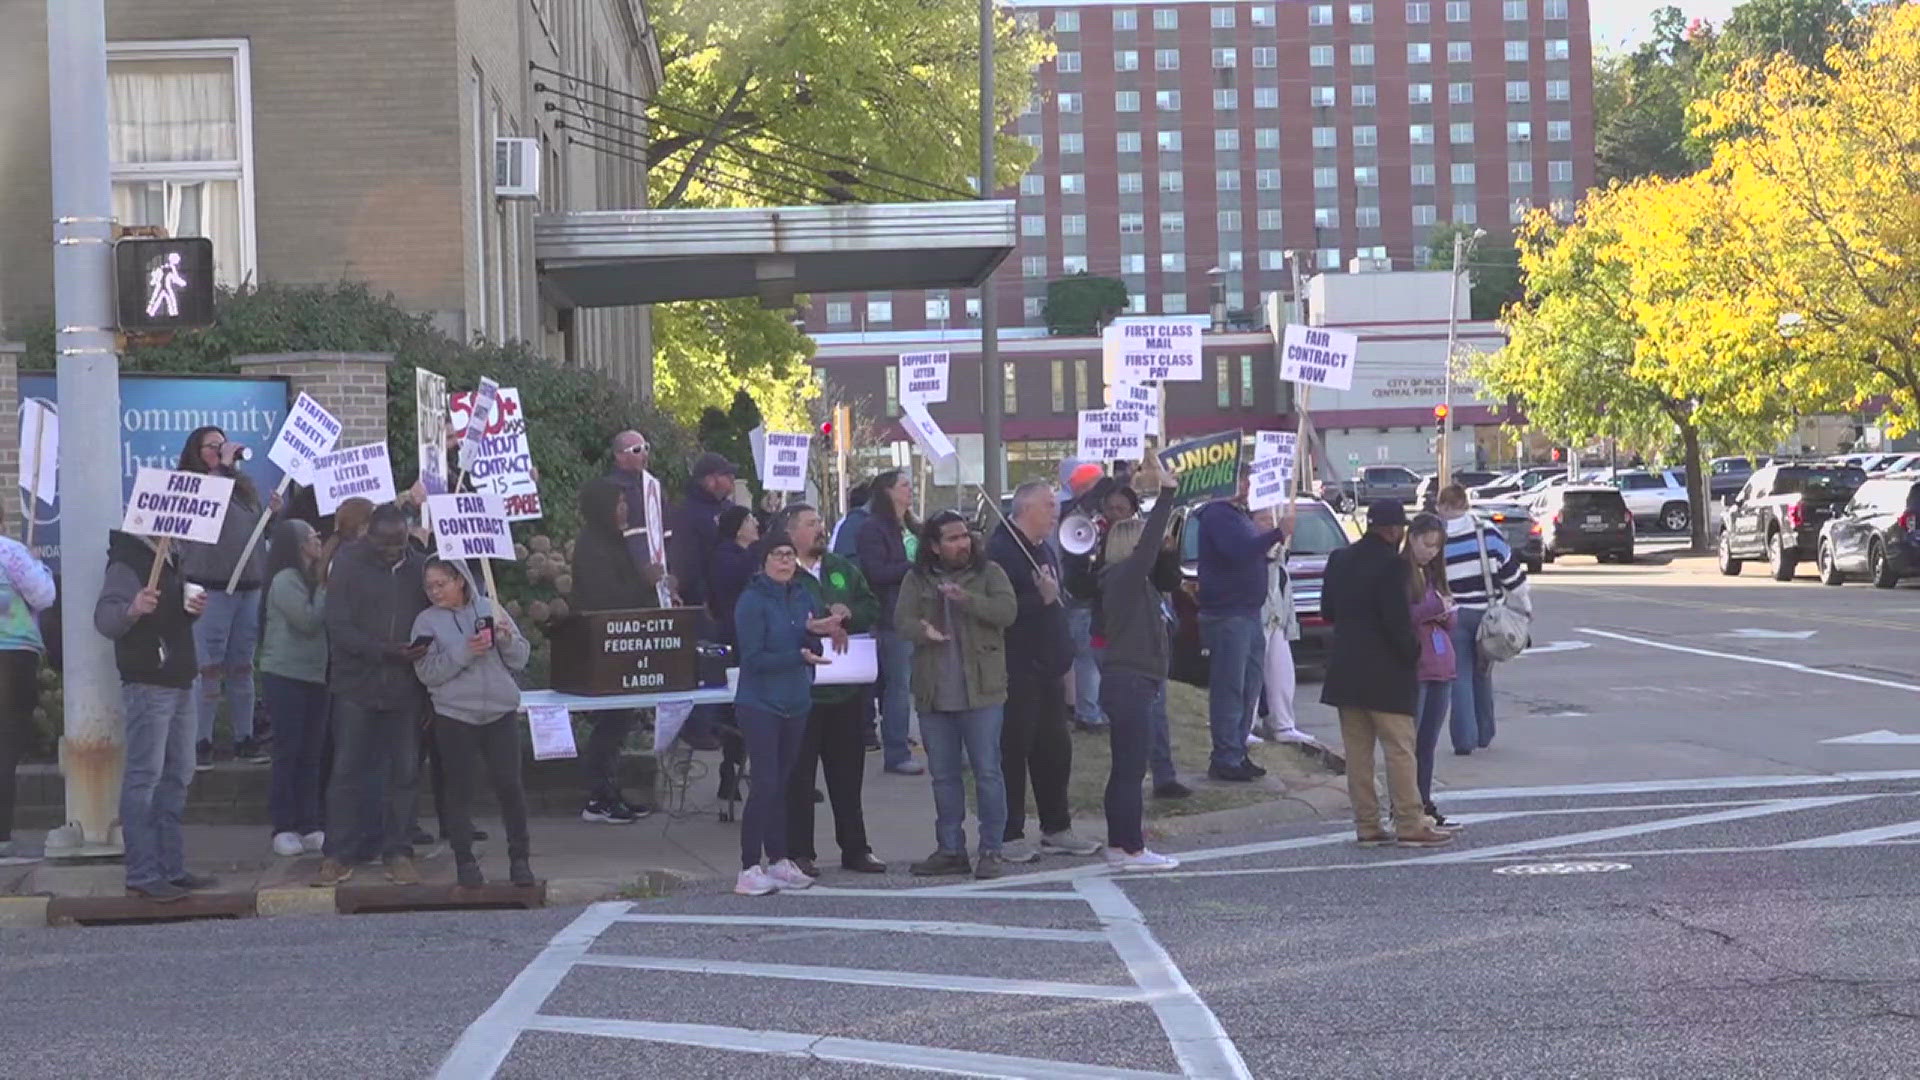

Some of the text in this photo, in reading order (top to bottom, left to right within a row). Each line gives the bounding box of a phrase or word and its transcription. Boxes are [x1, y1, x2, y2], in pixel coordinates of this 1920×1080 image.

[1125, 325, 1193, 337] FIRST CLASS
[1306, 330, 1330, 347] FAIR
[1146, 339, 1172, 349] MAIL
[902, 353, 946, 366] SUPPORT OUR
[1125, 355, 1193, 366] FIRST CLASS
[1288, 345, 1347, 368] CONTRACT
[1150, 367, 1169, 378] PAY
[1299, 365, 1326, 383] NOW
[1387, 379, 1407, 387] CITY
[1437, 386, 1473, 395] STTION
[1130, 386, 1148, 401] FAIR
[298, 396, 340, 437] STAFFING
[1116, 400, 1156, 417] CONTRAC
[121, 401, 277, 440] ommunity
[1085, 412, 1139, 422] FIRST CLASS
[294, 416, 327, 448] SAFETY
[1101, 423, 1122, 433] MAIL
[283, 430, 316, 459] SERVIC
[1085, 437, 1138, 448] FIRST CLASS
[313, 445, 385, 470] SUPPORT OUR
[1103, 449, 1118, 458] PAY
[1166, 439, 1237, 473] UNION
[334, 464, 369, 482] LETTER
[167, 474, 202, 494] FAIR
[329, 477, 381, 499] CARRIERS
[137, 492, 221, 518] CONTRACT
[456, 497, 485, 513] FAIR
[152, 516, 192, 535] NOW
[438, 519, 505, 535] CONTRACT
[463, 538, 496, 554] NOW
[606, 619, 674, 634] QUAD-CITY
[604, 637, 681, 653] FEDERATION
[637, 656, 648, 668] of
[622, 673, 664, 688] LABOR
